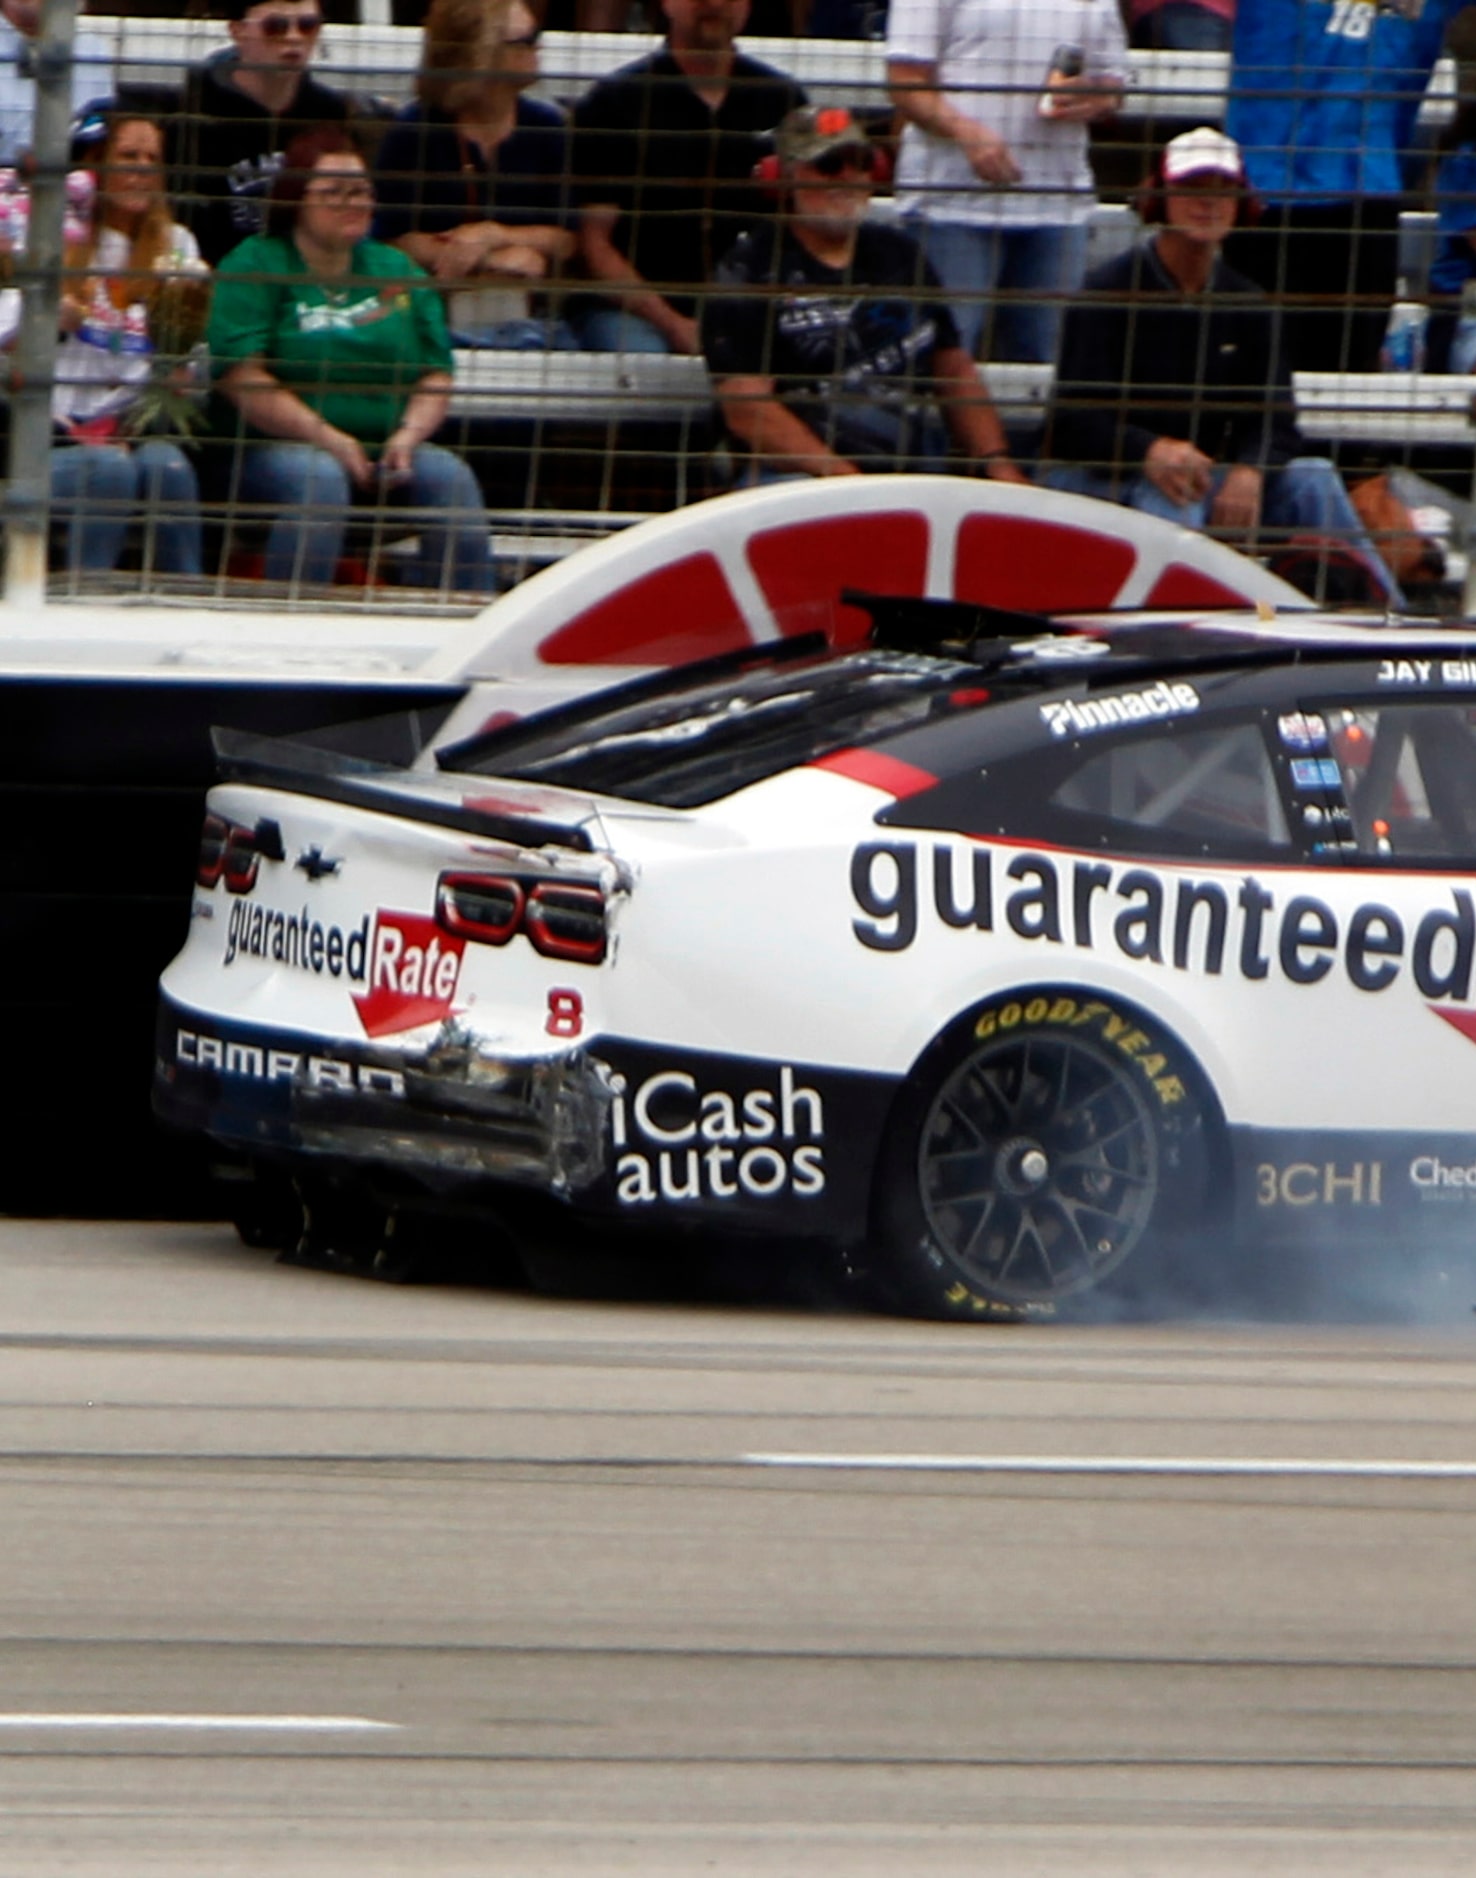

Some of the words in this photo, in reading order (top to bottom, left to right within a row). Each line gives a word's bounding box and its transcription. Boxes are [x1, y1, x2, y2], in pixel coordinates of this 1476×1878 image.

[1377, 660, 1431, 682] JAY
[1040, 681, 1202, 738] Pinnacle
[222, 898, 370, 982] guaranteed
[373, 923, 459, 999] Rate
[543, 986, 583, 1039] 8
[974, 997, 1186, 1104] GOODYEAR
[615, 1143, 826, 1204] autos
[1255, 1162, 1382, 1206] 3CHI
